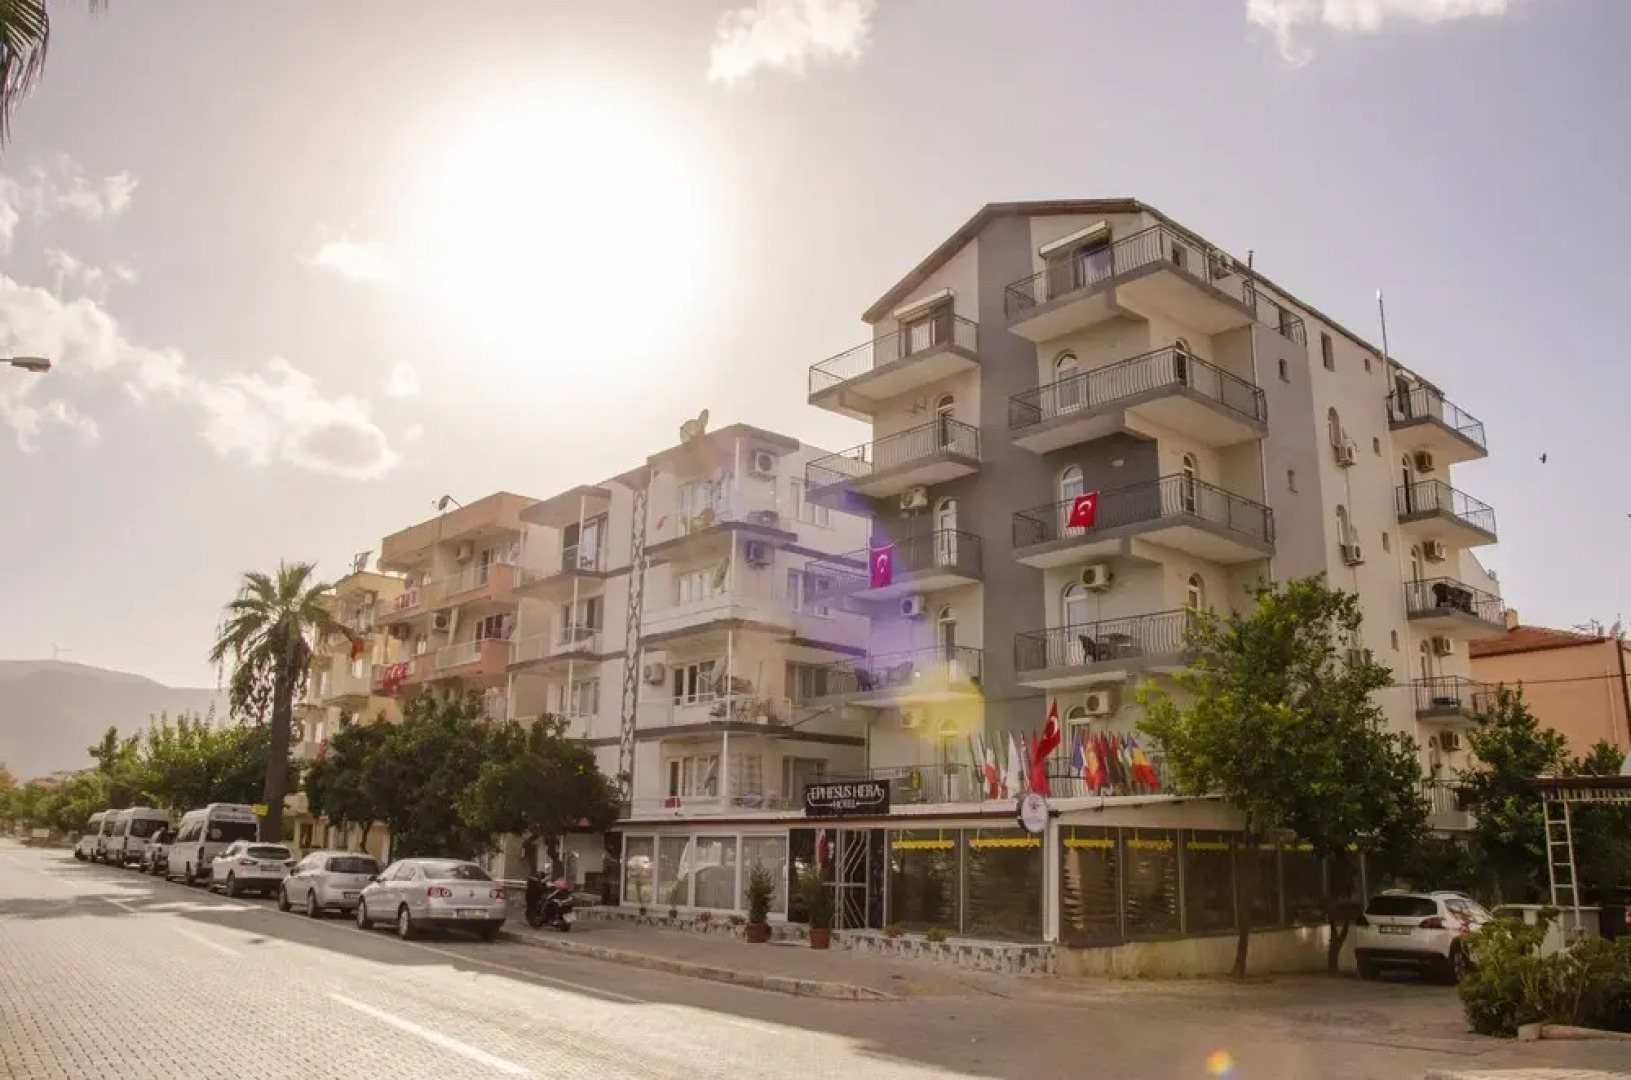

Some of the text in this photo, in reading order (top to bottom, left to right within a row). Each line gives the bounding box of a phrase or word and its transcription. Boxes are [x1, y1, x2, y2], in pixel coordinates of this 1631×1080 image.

[809, 784, 883, 800] EPHESUS HERA
[832, 799, 857, 809] HOTEL
